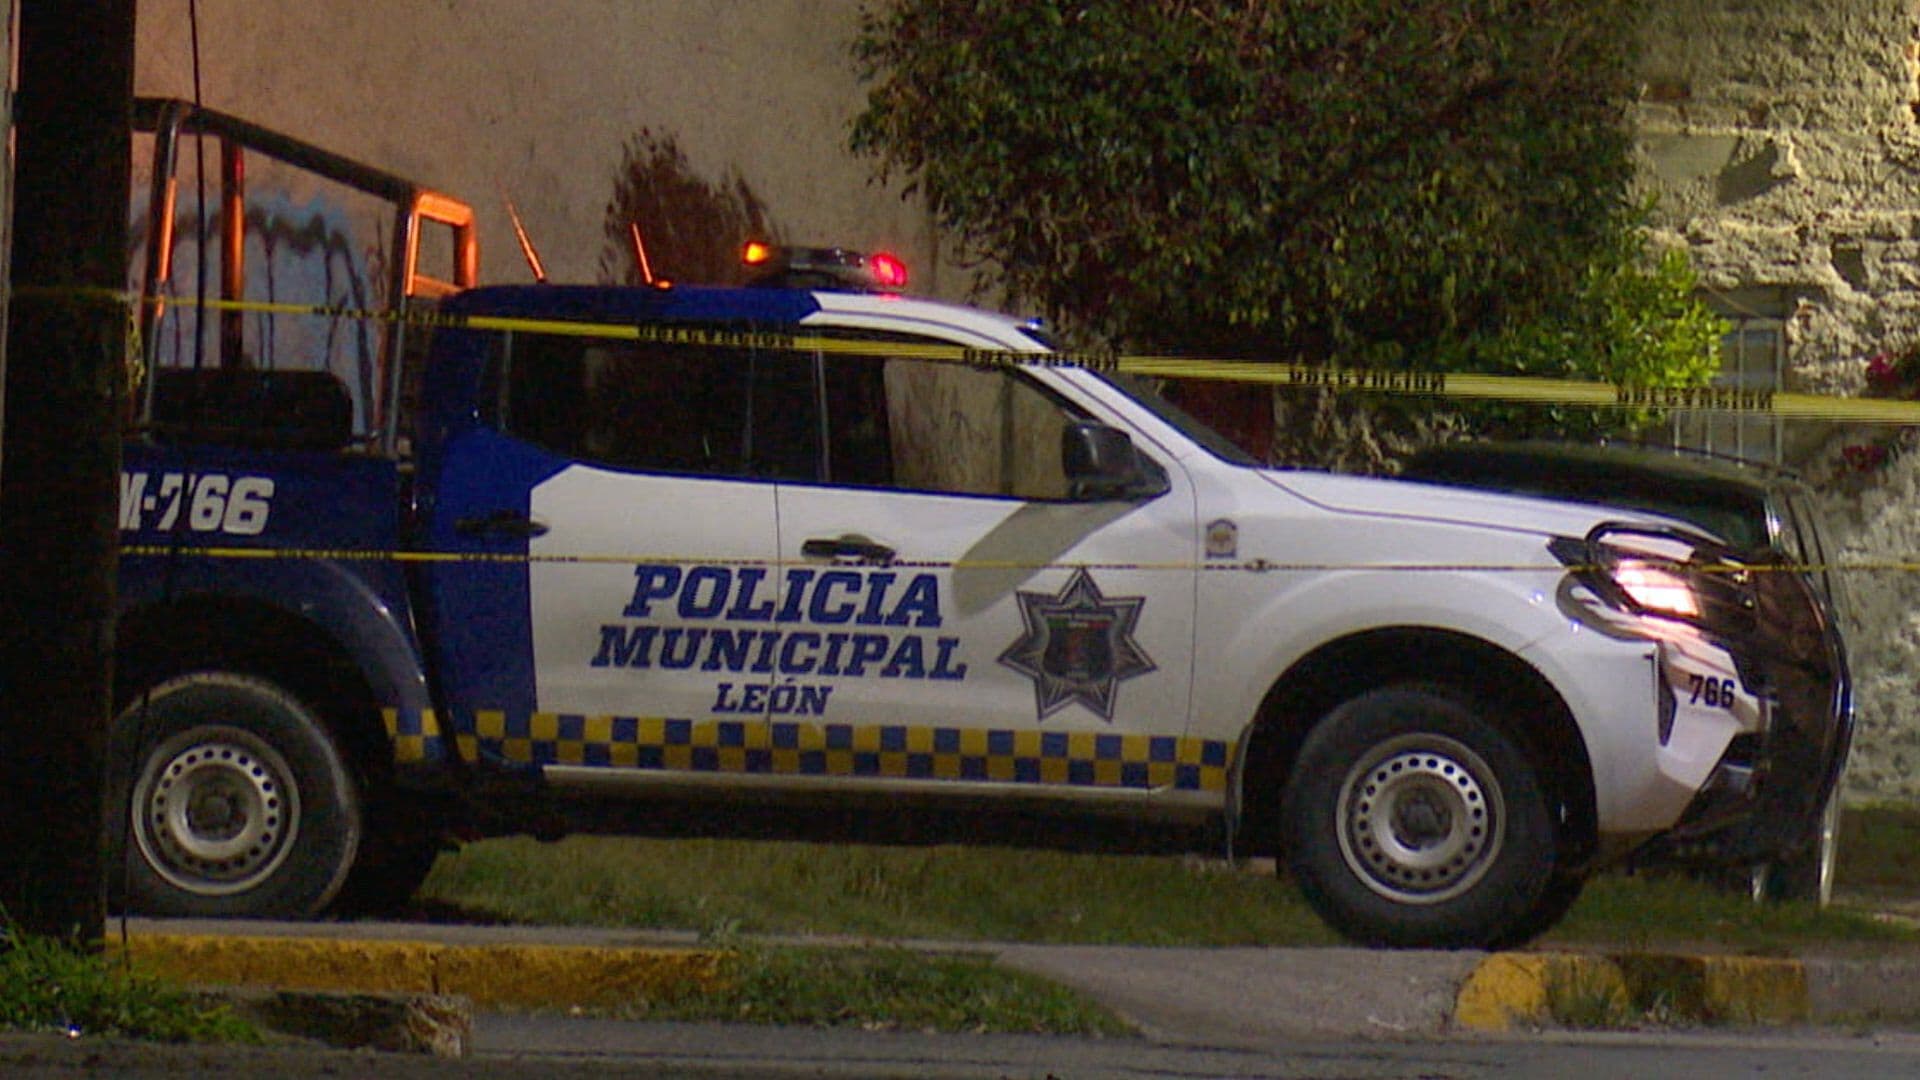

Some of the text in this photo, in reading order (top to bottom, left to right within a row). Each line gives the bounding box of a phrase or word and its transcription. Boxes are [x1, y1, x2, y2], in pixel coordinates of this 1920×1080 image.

[590, 625, 968, 681] MUNICIPAL
[711, 678, 833, 715] LEÓN
[1688, 674, 1735, 708] 766
